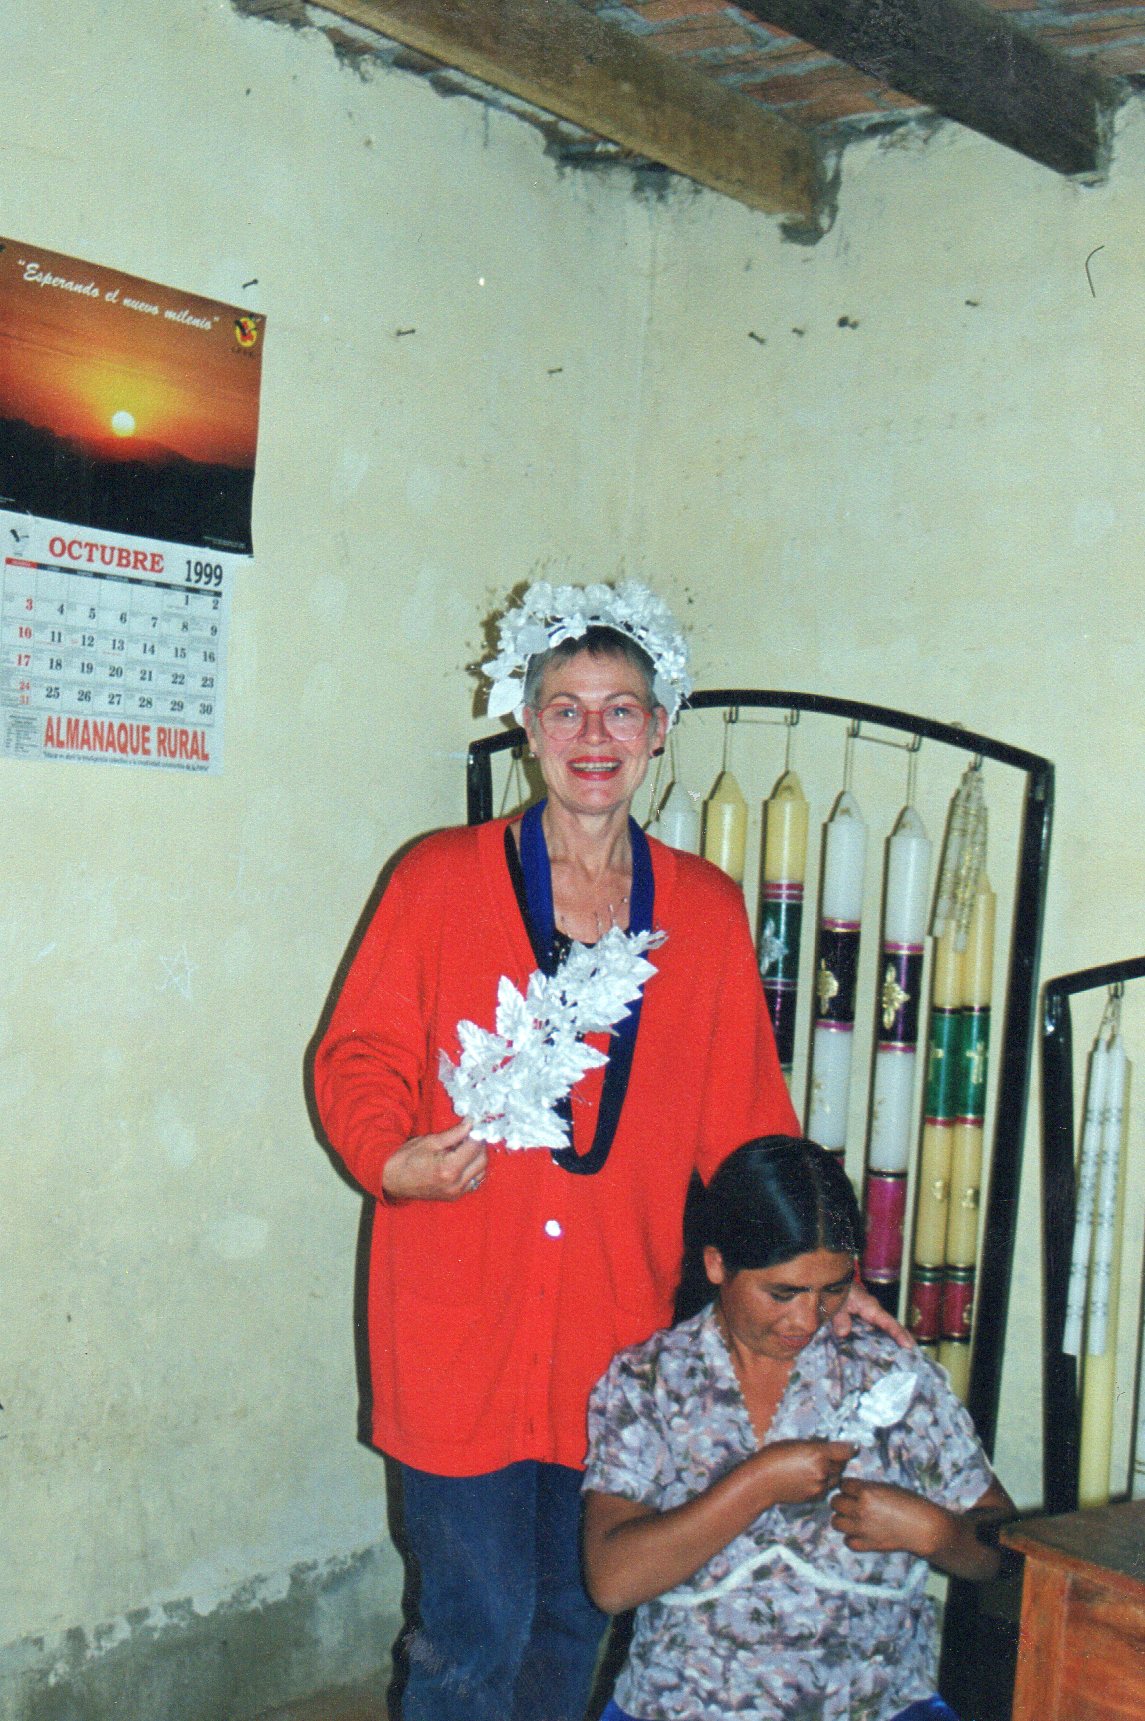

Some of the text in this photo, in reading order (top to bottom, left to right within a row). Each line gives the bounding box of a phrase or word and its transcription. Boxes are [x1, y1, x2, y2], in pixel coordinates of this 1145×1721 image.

[105, 288, 119, 303] el
[122, 297, 159, 315] nuevo
[49, 537, 164, 573] OCTUBRE
[185, 560, 223, 587] 1999
[26, 599, 33, 611] 3
[57, 604, 65, 615] 4
[89, 608, 96, 620] 5
[120, 612, 127, 624] 6
[151, 617, 158, 628] 7
[210, 625, 218, 636] 9
[184, 595, 219, 610] 1 2
[18, 626, 215, 662] 10 11 12 13 14 15 16
[16, 654, 214, 688] 17 18 19 20 21 22 23
[45, 687, 60, 699] 25
[77, 690, 92, 702] 26
[108, 694, 122, 706] 27
[138, 696, 153, 709] 28
[170, 700, 184, 712] 29
[199, 703, 213, 715] 30
[44, 715, 151, 756] ALMANAQUE
[156, 726, 209, 761] RURAL
